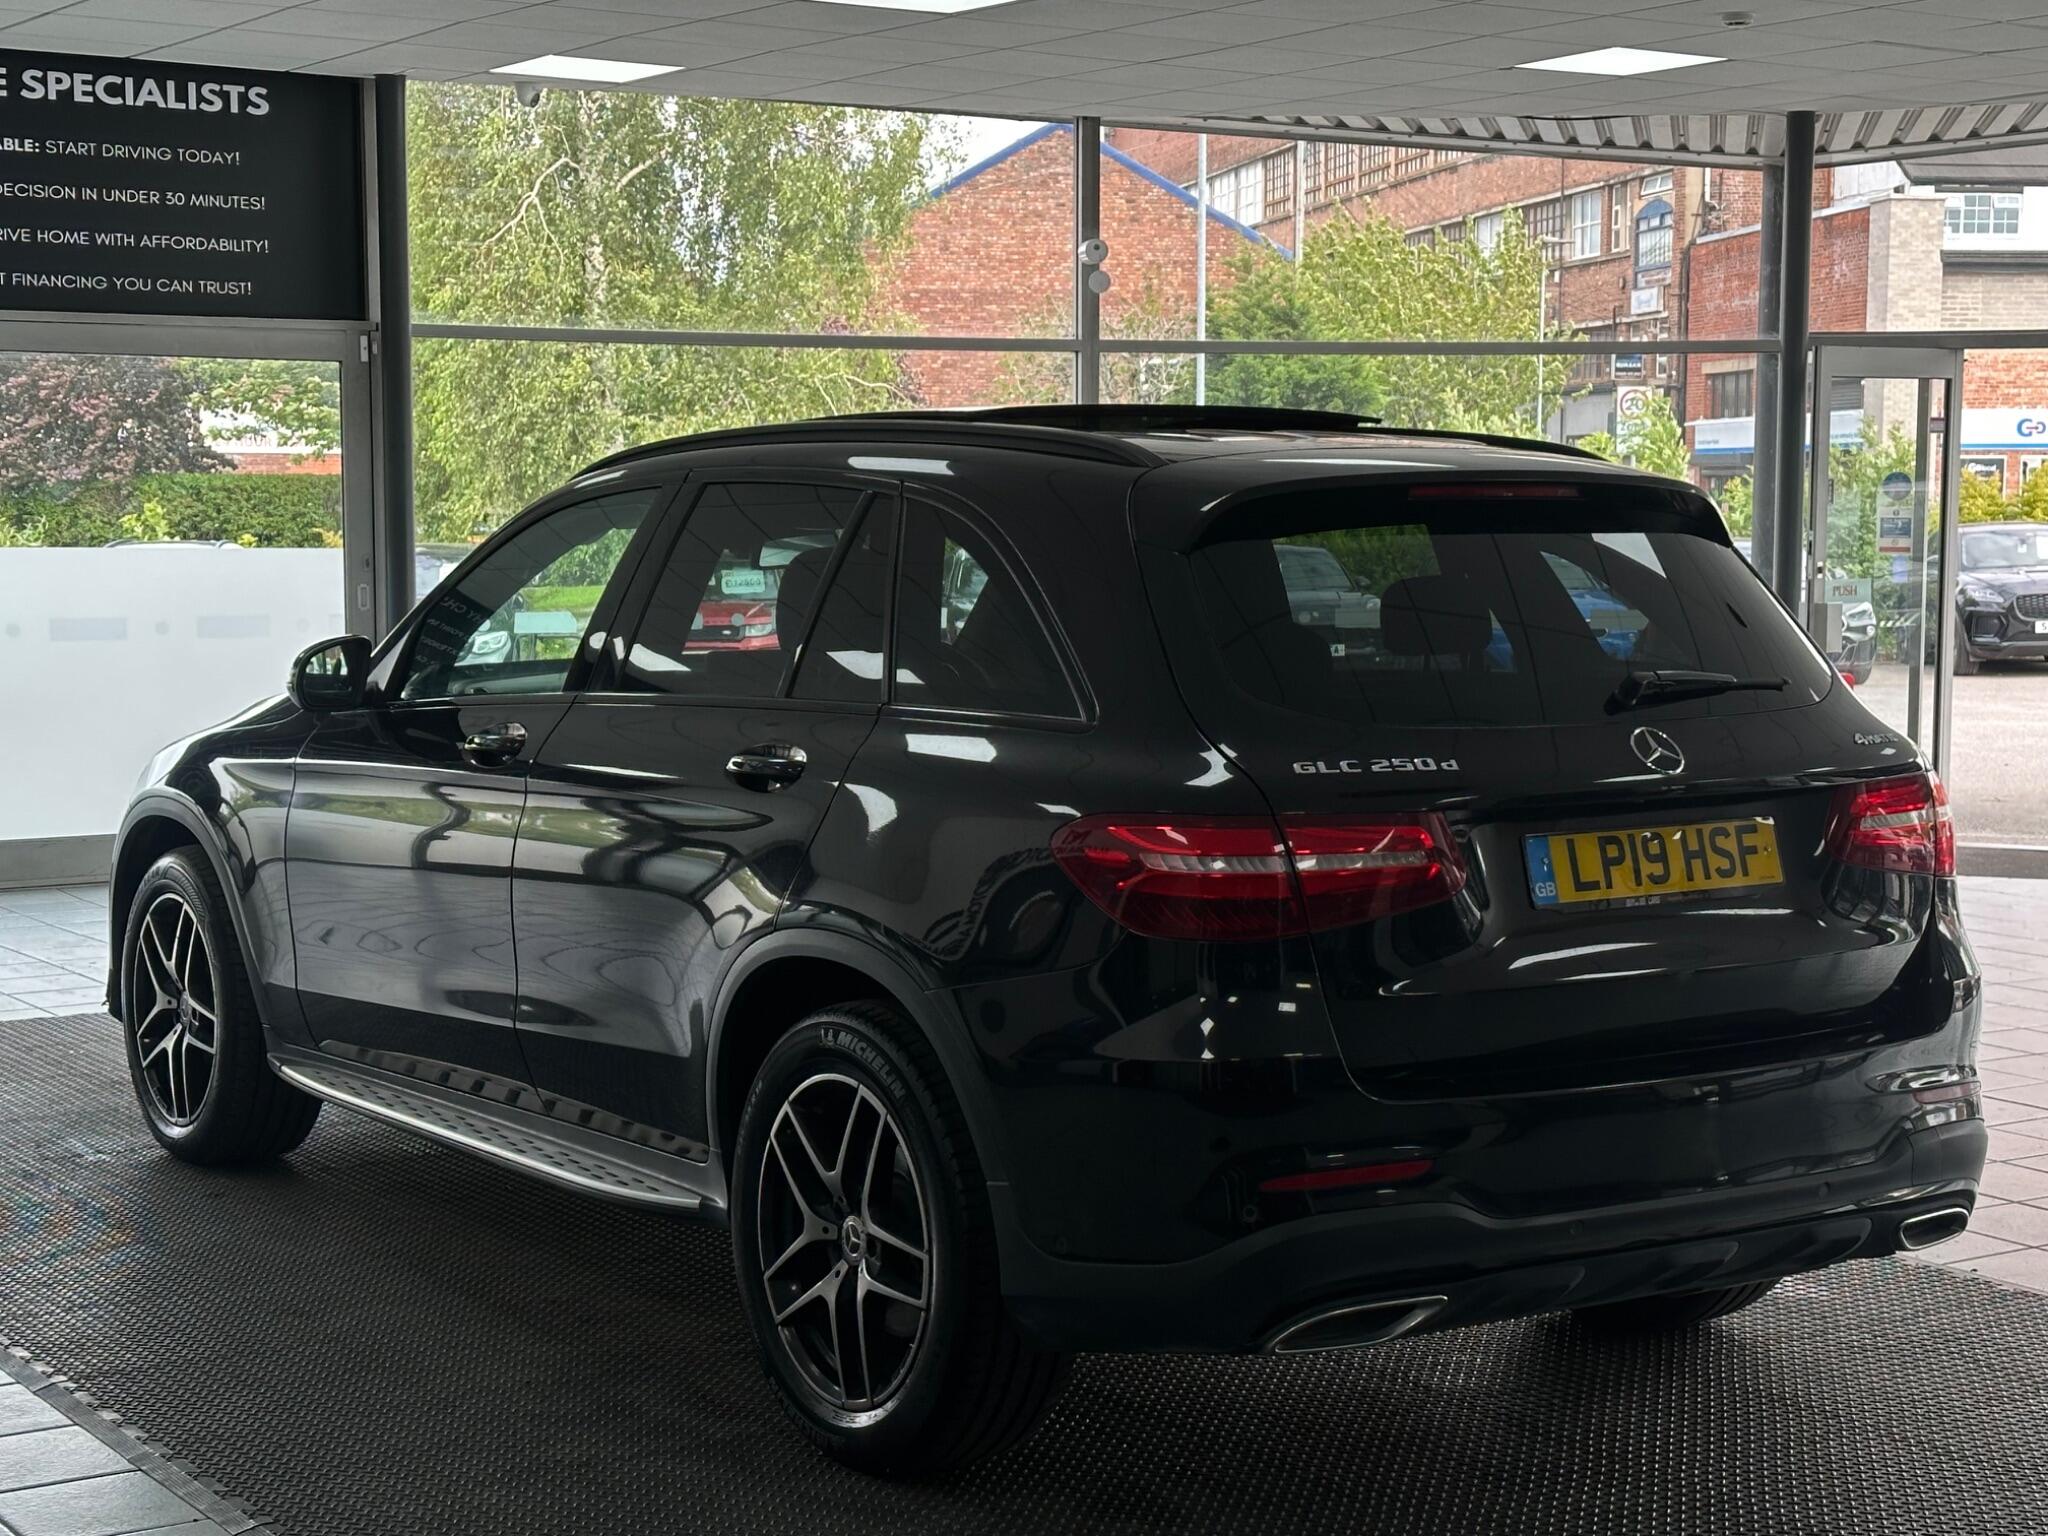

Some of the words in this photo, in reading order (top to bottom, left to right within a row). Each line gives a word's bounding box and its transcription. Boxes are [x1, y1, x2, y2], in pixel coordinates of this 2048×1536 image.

[20, 69, 270, 116] SPECIALISTS
[0, 137, 40, 153] BLE:
[45, 140, 97, 156] START
[102, 143, 172, 161] DRIVING
[177, 148, 240, 166] TODAY!
[0, 182, 76, 200] ECISION
[82, 187, 97, 201] IN
[103, 188, 161, 205] UNDER
[165, 191, 185, 206] 30
[190, 193, 265, 211] MINUTES!
[37, 229, 90, 245] HOME
[95, 232, 135, 247] WITH
[140, 234, 269, 254] AFFORDABILITY!
[12, 272, 107, 290] FINANCING
[113, 276, 151, 292] YOU
[156, 278, 193, 294] CAN
[198, 280, 252, 296] TRUST!
[1625, 397, 1645, 411] 20
[1832, 584, 1858, 597] PUSH
[1292, 760, 1362, 774] GLC
[1566, 831, 1671, 893] LP19
[1680, 823, 1759, 882] HSF
[1535, 882, 1556, 898] GB
[836, 1030, 906, 1099] MICHELIN
